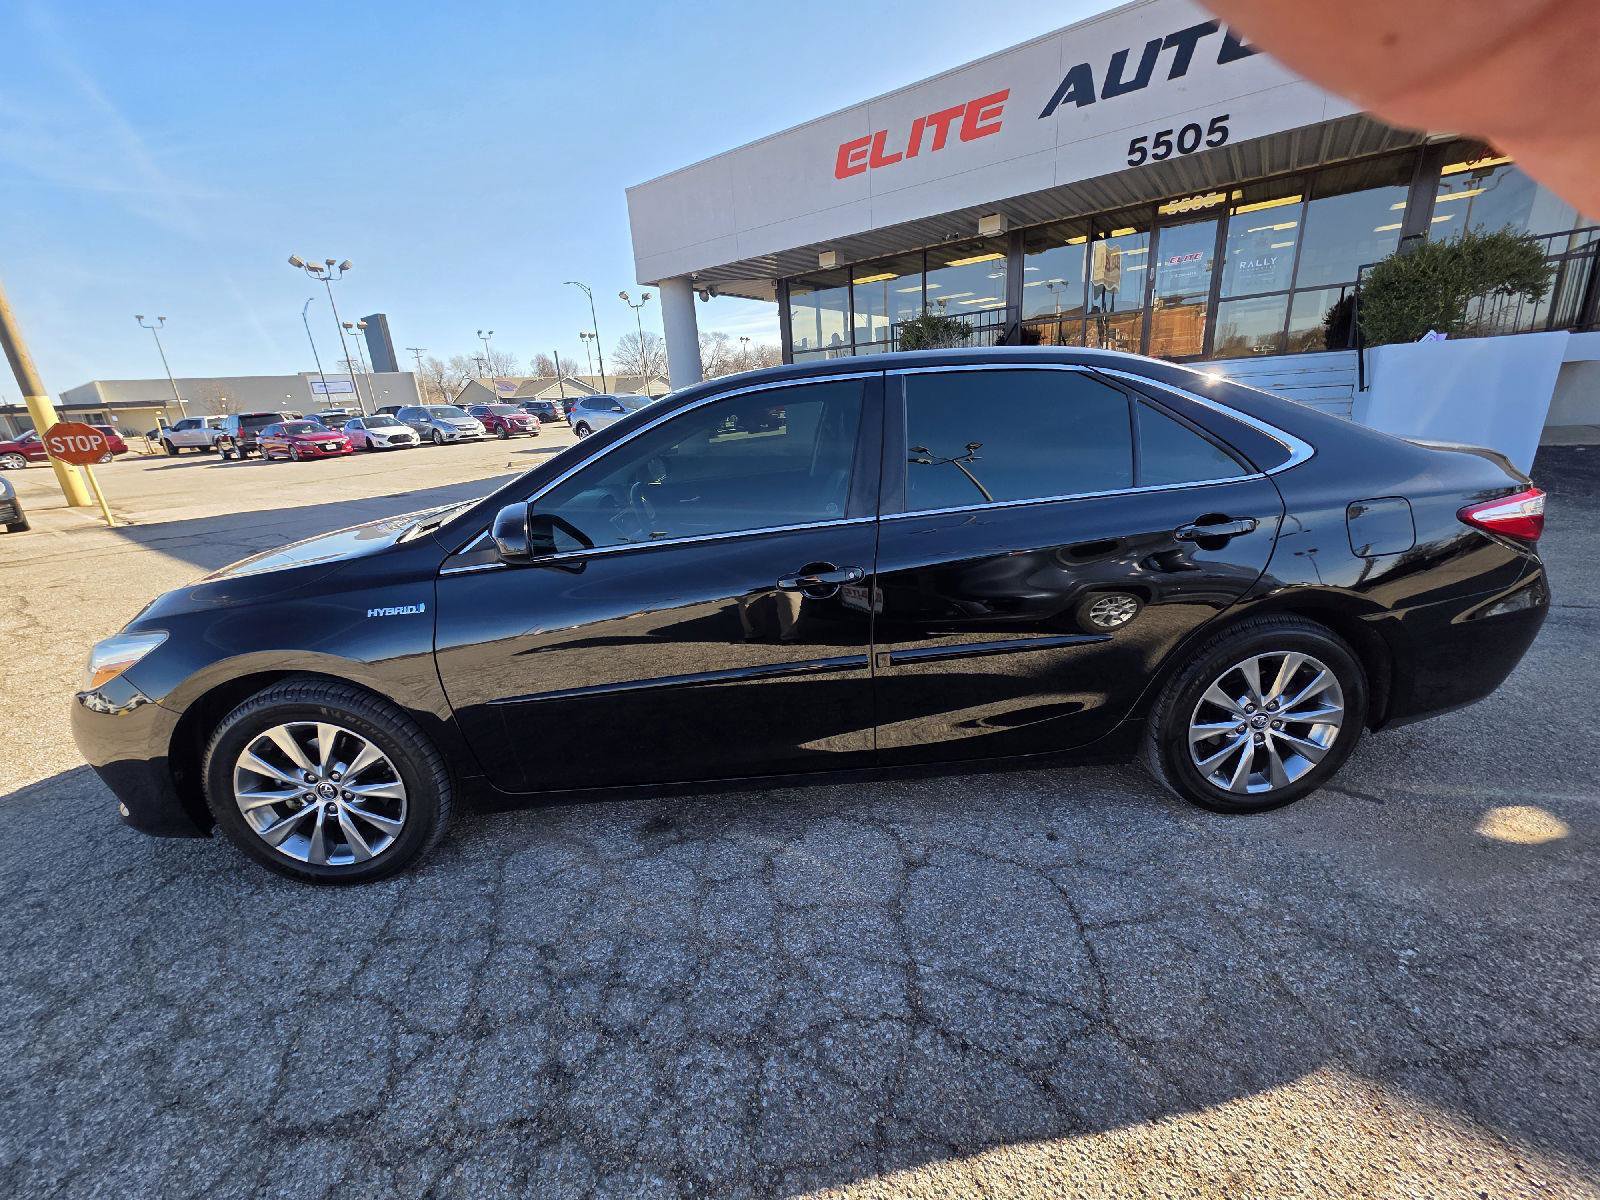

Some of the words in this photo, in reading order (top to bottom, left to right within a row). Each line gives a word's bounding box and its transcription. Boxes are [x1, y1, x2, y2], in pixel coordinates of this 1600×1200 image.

[834, 88, 1010, 180] ELITE
[1127, 114, 1230, 167] 5505
[1240, 256, 1279, 269] RALLY
[50, 435, 102, 453] STOP
[367, 605, 417, 618] HYBRID
